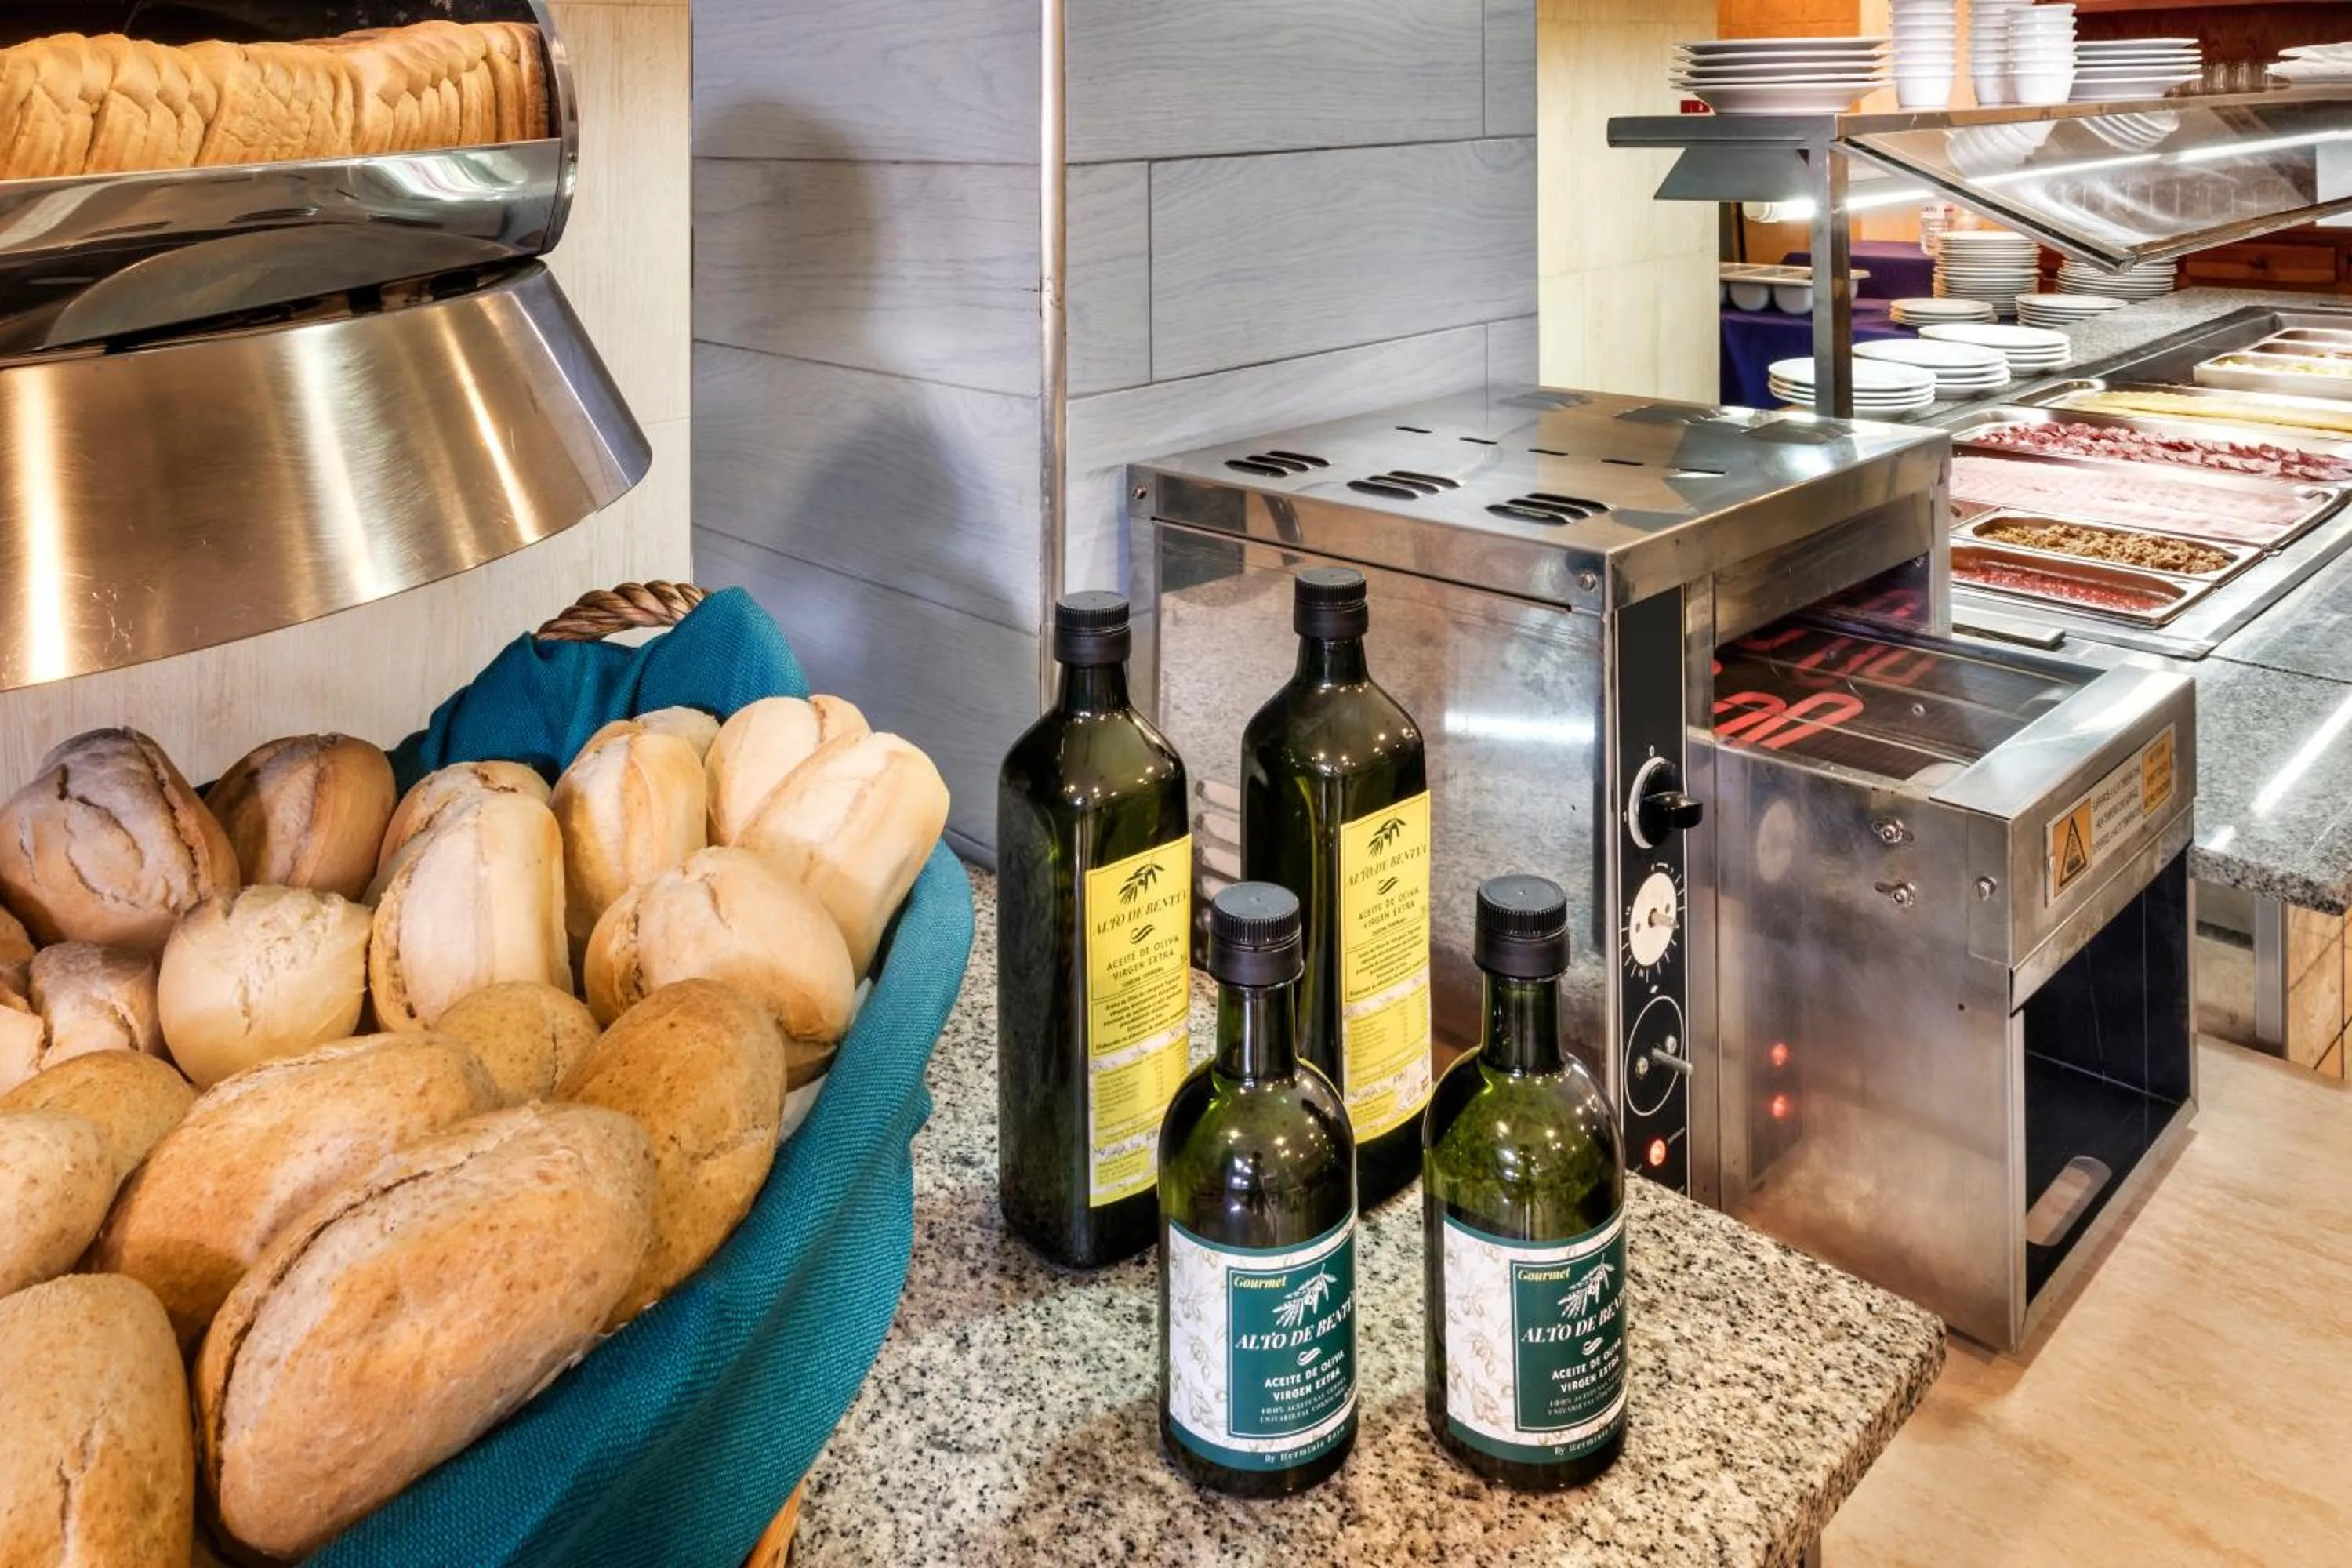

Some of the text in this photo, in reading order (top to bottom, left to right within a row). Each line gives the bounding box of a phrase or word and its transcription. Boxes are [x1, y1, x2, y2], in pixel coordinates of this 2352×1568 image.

[1359, 887, 1420, 920] ACEITE DE OLIVA
[1363, 911, 1389, 929] VIRGEN
[1393, 899, 1415, 916] EXTRA
[1105, 935, 1179, 972] ACEITE DE OLIVA
[1112, 962, 1144, 980] VIRGEN
[1149, 949, 1174, 965] EXTRA
[1233, 1274, 1287, 1290] Gourmet
[1517, 1267, 1570, 1283] Gourmet
[1235, 1331, 1287, 1350] ALTO
[1290, 1324, 1315, 1347] DE
[1521, 1323, 1571, 1343] ALTO
[1575, 1315, 1597, 1337] DE
[1265, 1349, 1345, 1388] ACEITE DE OLIVA
[1552, 1363, 1587, 1381] ACEITE
[1589, 1356, 1601, 1370] DE
[1560, 1373, 1597, 1393] VIRGEN
[1272, 1383, 1312, 1402] VIRGEN
[1315, 1366, 1341, 1390] EXTRA
